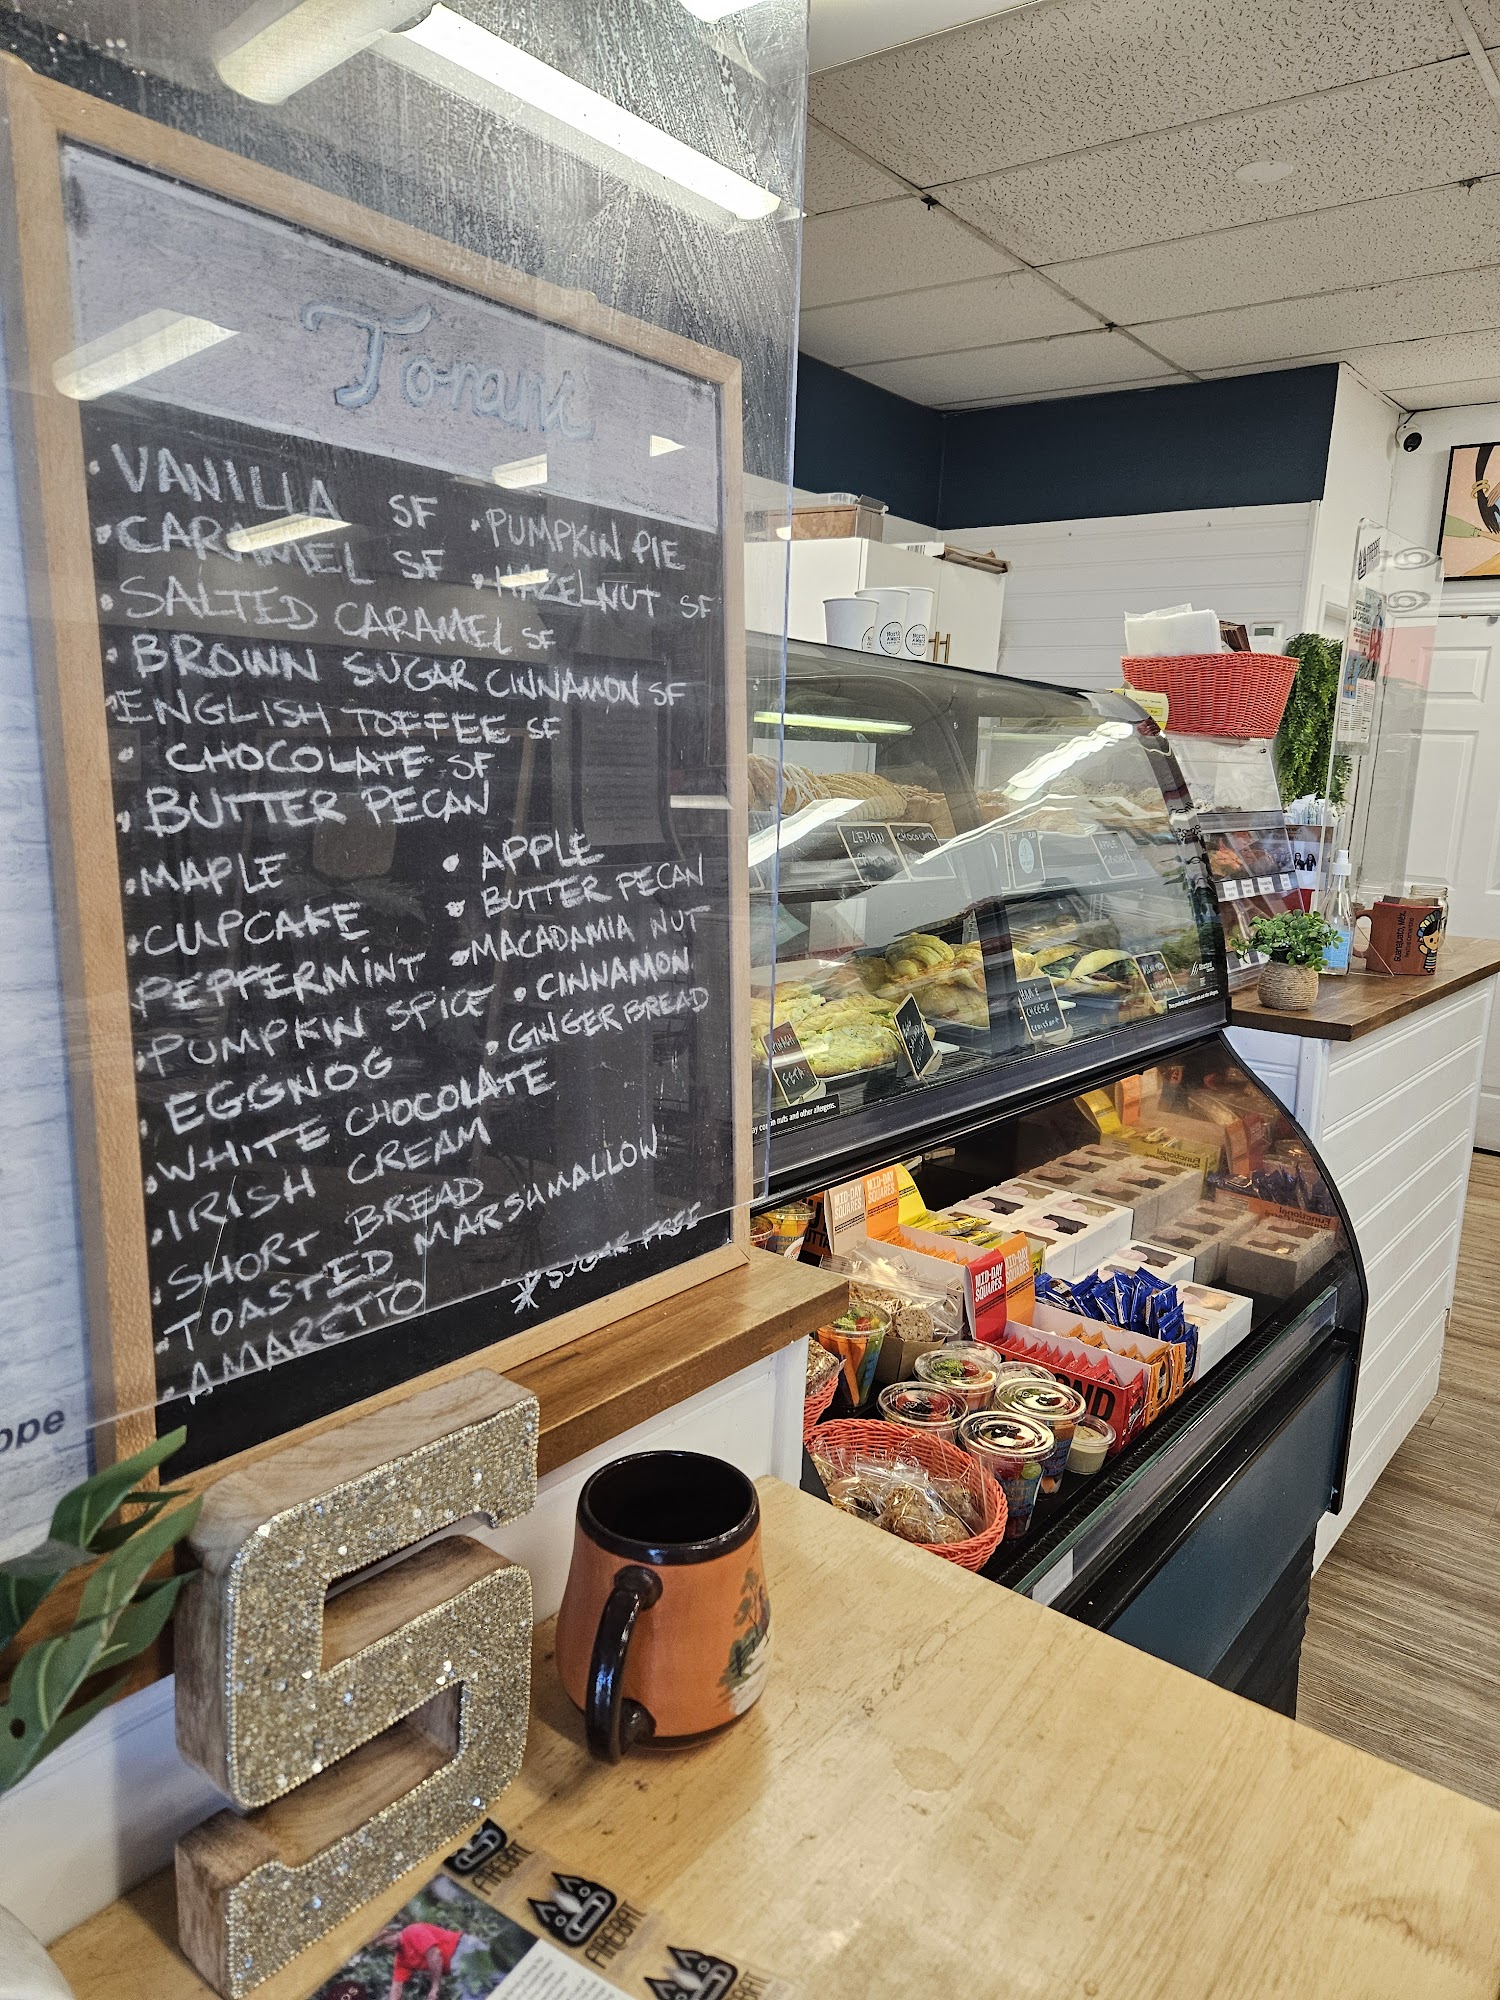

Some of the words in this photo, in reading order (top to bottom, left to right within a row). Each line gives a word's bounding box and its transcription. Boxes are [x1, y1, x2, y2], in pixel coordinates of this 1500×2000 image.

[111, 444, 342, 520] VANILLA
[388, 494, 438, 529] SF
[393, 549, 445, 581] SF
[485, 508, 622, 563] PUMPKIN
[631, 529, 686, 570] PIE
[119, 575, 319, 630] SALTED
[333, 602, 513, 655] CARAMEL
[522, 627, 557, 650] SF
[680, 594, 717, 619] SF
[131, 633, 322, 681] BROWN
[342, 650, 478, 693] SUGAR
[485, 667, 641, 707] CINNAMON
[648, 682, 687, 706] SF
[116, 688, 332, 738] ENGLISH
[340, 706, 512, 744] TOFFEE
[526, 717, 562, 740] SF
[165, 739, 430, 780] CHOCOLATE
[447, 752, 495, 780] SF
[144, 786, 348, 838] BUTTER
[360, 780, 490, 828] PECAN
[140, 852, 289, 896] MAPLE
[481, 828, 605, 881] APPLE
[481, 874, 612, 918] BUTTER
[616, 853, 704, 902] PECAN
[143, 902, 370, 956] CUPCAKE
[472, 913, 636, 966] MACADAMIA
[650, 904, 711, 939] NUT
[535, 946, 690, 1001] CINNAMON
[147, 1006, 368, 1079] PUMPKIN
[157, 1115, 331, 1181] WHITE
[345, 1057, 556, 1137] CHOCOLATE
[164, 1046, 394, 1135] EGGNOG
[167, 1166, 317, 1241] IRISH
[347, 1116, 492, 1185] CREAM
[834, 1184, 862, 1207] MID-DAY
[866, 1169, 894, 1190] MID-DAY
[163, 1249, 394, 1352] TOASTED
[414, 1123, 657, 1256] MARSHMALLOW
[167, 1229, 320, 1301] SHORT
[345, 1177, 484, 1245] BREAD
[1004, 1245, 1028, 1269] MID-DAY
[975, 1262, 1003, 1288] MID-DAY
[585, 1899, 648, 1970] FIREBAT
